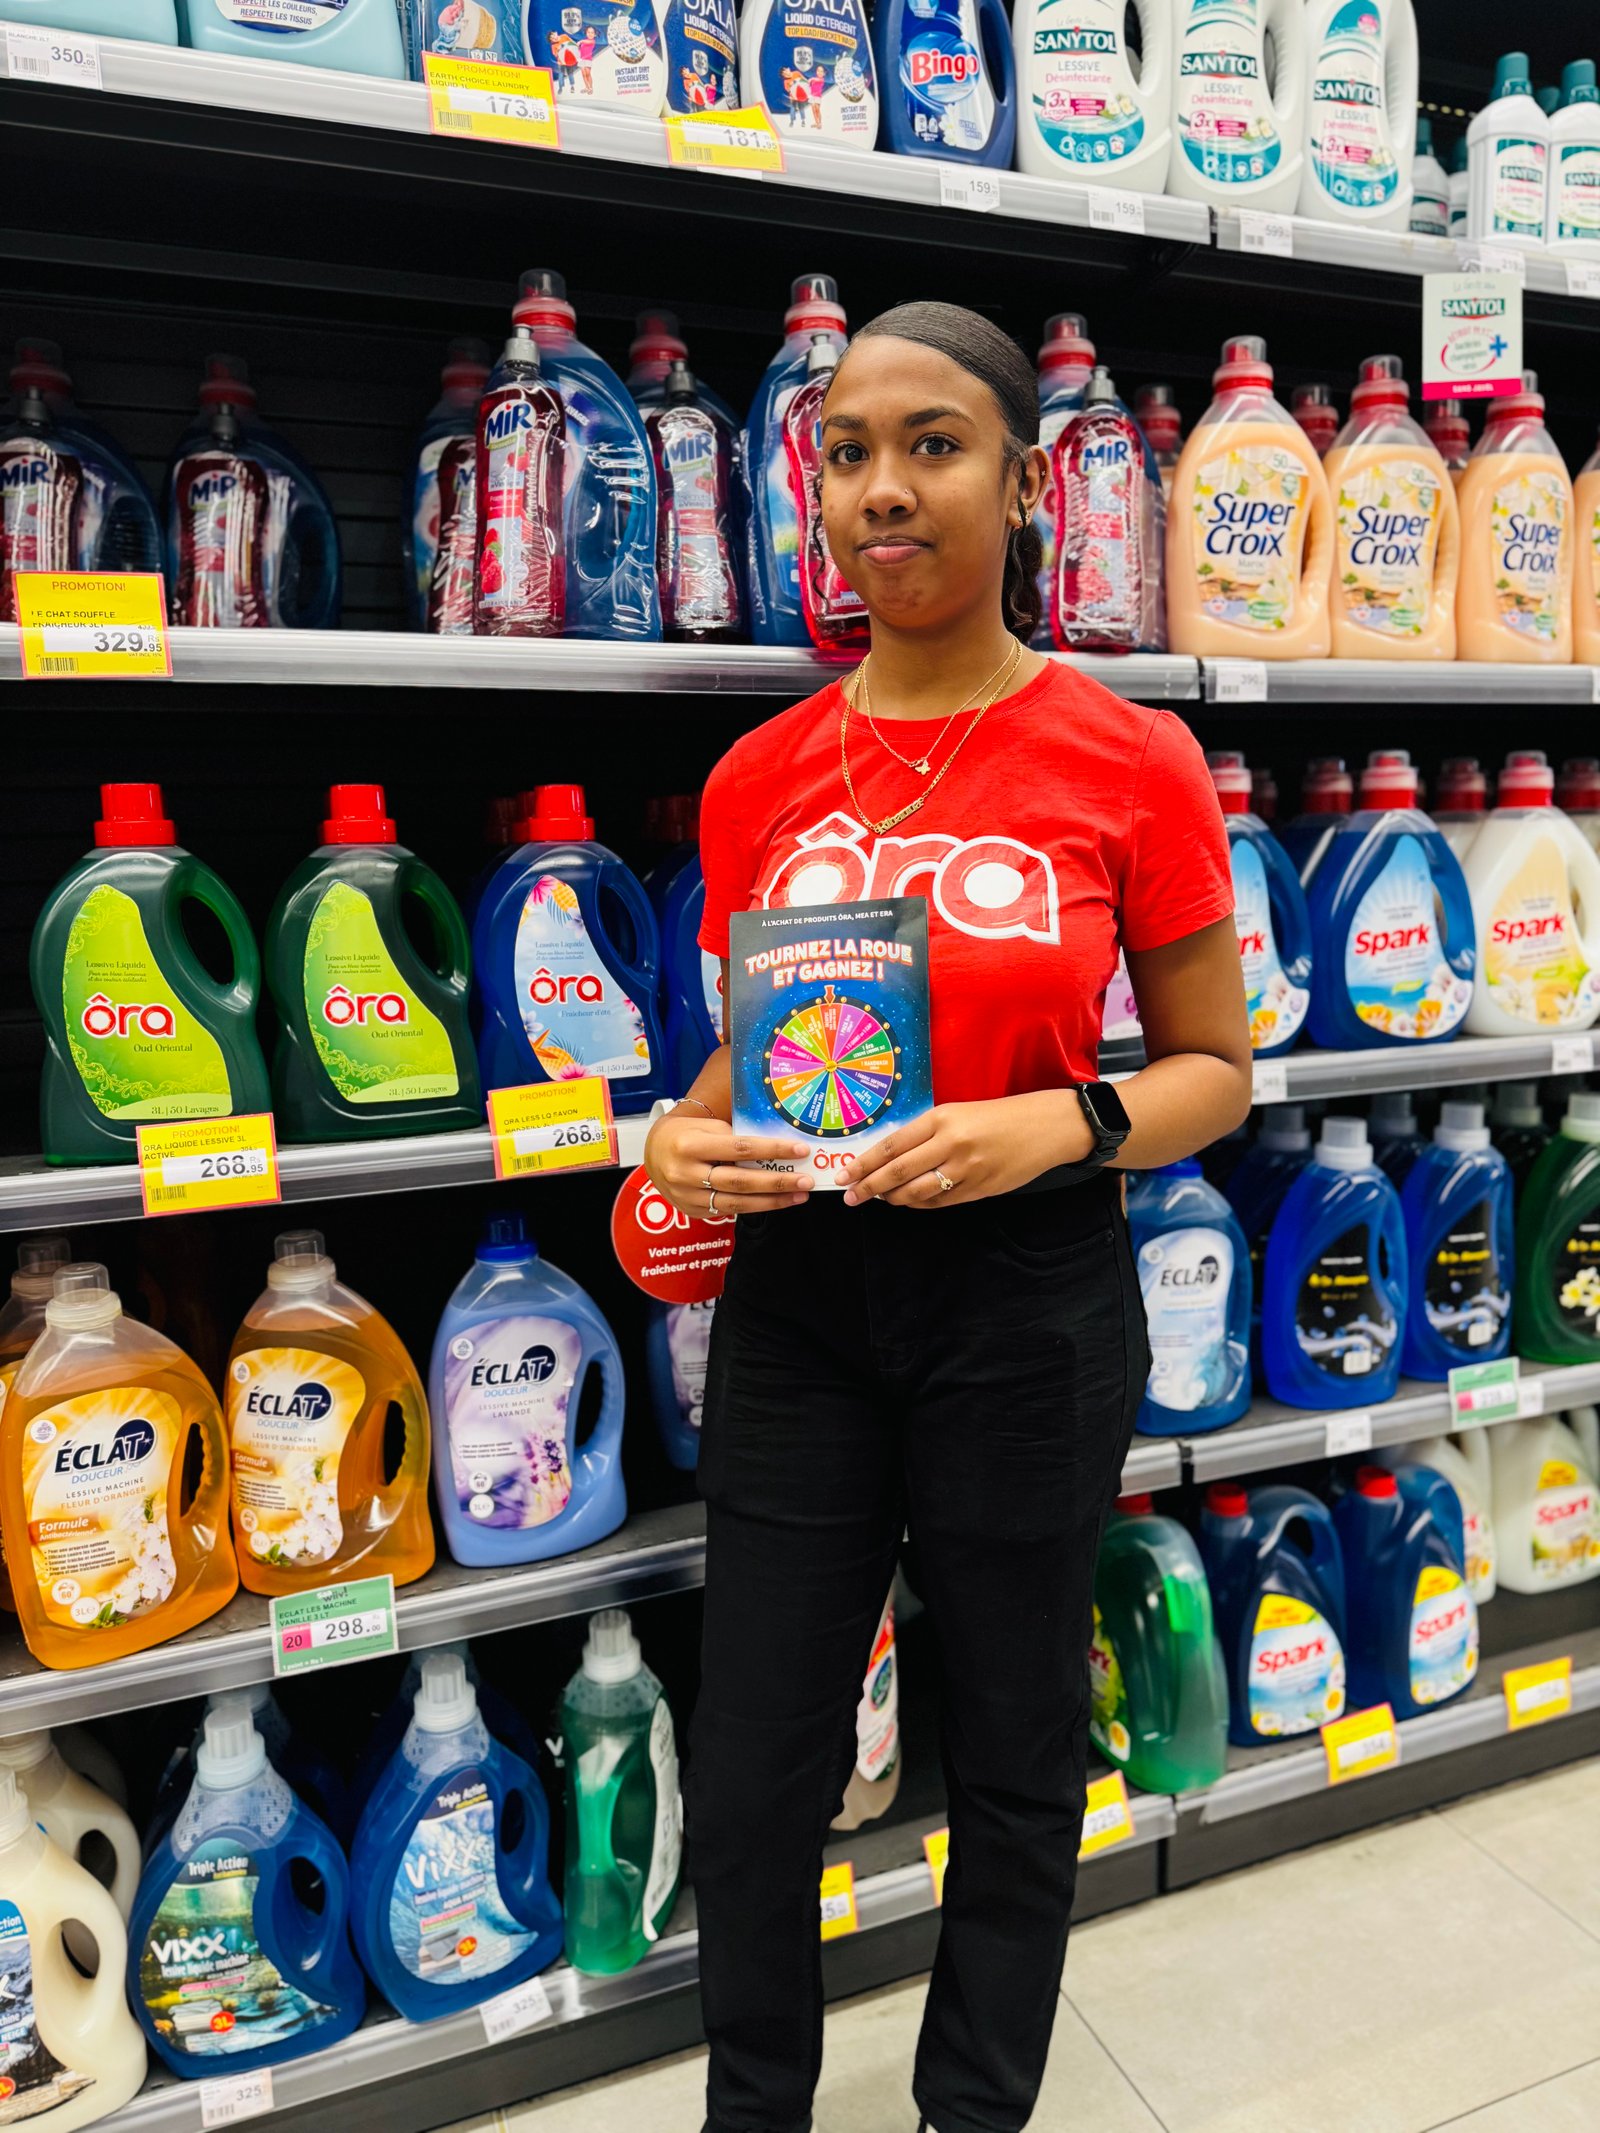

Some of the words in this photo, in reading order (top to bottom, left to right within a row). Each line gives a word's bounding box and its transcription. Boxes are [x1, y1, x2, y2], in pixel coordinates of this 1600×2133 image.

[240, 8, 273, 19] RESPECTE
[275, 13, 288, 21] LES
[289, 15, 313, 25] TISSUS
[684, 15, 709, 31] LIQUID
[785, 14, 814, 26] LIQUID
[815, 16, 857, 36] DETERGENT
[787, 27, 800, 36] TOP
[1035, 31, 1117, 54] SANYTOL
[456, 63, 522, 80] PROMOTION!
[909, 50, 978, 86] Bingo
[1058, 61, 1101, 72] LESSIVE
[1182, 55, 1258, 78] SANYTOL
[430, 71, 459, 82] EARTH
[460, 76, 490, 87] CHOICE
[491, 81, 530, 92] LAUNDRY
[431, 80, 459, 90] LIQUID
[1046, 72, 1112, 85] Désinfectante
[1204, 83, 1244, 95] LESSIVE
[1314, 80, 1381, 106] SANYTOL
[1335, 109, 1370, 123] LESSIVE
[1442, 299, 1505, 317] SANYTOL
[1207, 492, 1296, 529] Super
[1351, 505, 1430, 540] Super
[1503, 513, 1561, 550] Super
[1205, 525, 1285, 558] Croix
[1350, 537, 1420, 568] Croix
[1503, 543, 1556, 573] Croix
[52, 580, 126, 592] PROMOTION!
[45, 610, 71, 620] CHAT
[761, 918, 767, 928] À
[768, 917, 793, 927] L'ACHAT
[794, 917, 802, 925] DE
[803, 915, 837, 924] PRODUITS
[838, 911, 854, 922] ÔRA,
[855, 911, 870, 920] MEA
[870, 911, 879, 919] ET
[880, 909, 893, 918] ERA
[1492, 912, 1566, 944] Spark
[1353, 924, 1431, 957] Spark
[86, 960, 114, 969] Lessive
[116, 960, 146, 970] Liquide
[325, 953, 352, 962] Lessive
[353, 953, 381, 963] Liquide
[745, 939, 832, 976] TOURNEZ
[833, 938, 859, 959] LA
[860, 938, 914, 967] ROUE
[772, 964, 797, 989] ET
[799, 960, 875, 983] GAGNEZ
[528, 965, 605, 1006] ôra
[81, 991, 177, 1039] ôra
[322, 984, 409, 1029] ôra
[371, 1029, 389, 1039] Oud
[390, 1028, 424, 1039] Oriental
[133, 1044, 153, 1053] Oud
[155, 1043, 193, 1053] Oriental
[417, 1085, 448, 1096] Lavages
[519, 1086, 577, 1102] PROMOTION!
[170, 1105, 183, 1115] 50
[184, 1105, 219, 1116] Lavages
[504, 1117, 520, 1127] ORA
[521, 1114, 540, 1124] LESS
[172, 1125, 240, 1139] PROMOTION!
[143, 1144, 163, 1152] ORA
[164, 1140, 198, 1150] LIQUIDE
[200, 1136, 235, 1147] LESSIVE
[237, 1135, 247, 1143] 3L
[144, 1151, 176, 1161] ACTIVE
[648, 1246, 677, 1260] Votre
[679, 1237, 731, 1257] partenaire
[640, 1262, 687, 1280] fraîcheur
[688, 1259, 700, 1270] et
[470, 1355, 547, 1387] ÉCLAT
[484, 1386, 529, 1398] DOUCEUR
[246, 1386, 324, 1420] ÉCLAT
[512, 1397, 546, 1409] MACHINE
[493, 1408, 532, 1419] LAVANDE
[257, 1418, 299, 1430] DOUCEUR
[252, 1432, 280, 1443] LESSIVE
[281, 1435, 317, 1444] MACHINE
[54, 1431, 146, 1475] ÉCLAT
[234, 1452, 268, 1469] Formule
[71, 1466, 124, 1485] DOUCEUR
[66, 1487, 102, 1500] LESSIVE
[105, 1477, 145, 1493] MACHINE
[60, 1497, 92, 1511] FLEUR
[93, 1486, 147, 1505] D'ORANGER
[39, 1516, 89, 1534] Formule
[279, 1608, 305, 1620] ECLAT
[306, 1605, 321, 1615] LES
[322, 1598, 358, 1611] MACHINE
[279, 1614, 313, 1628] VANILLE
[285, 1634, 303, 1649] 20
[1256, 1637, 1329, 1675] Spark
[188, 1859, 215, 1877] Triple
[215, 1856, 248, 1873] Action
[212, 2015, 233, 2030] 3L
[236, 2084, 262, 2102] 325
